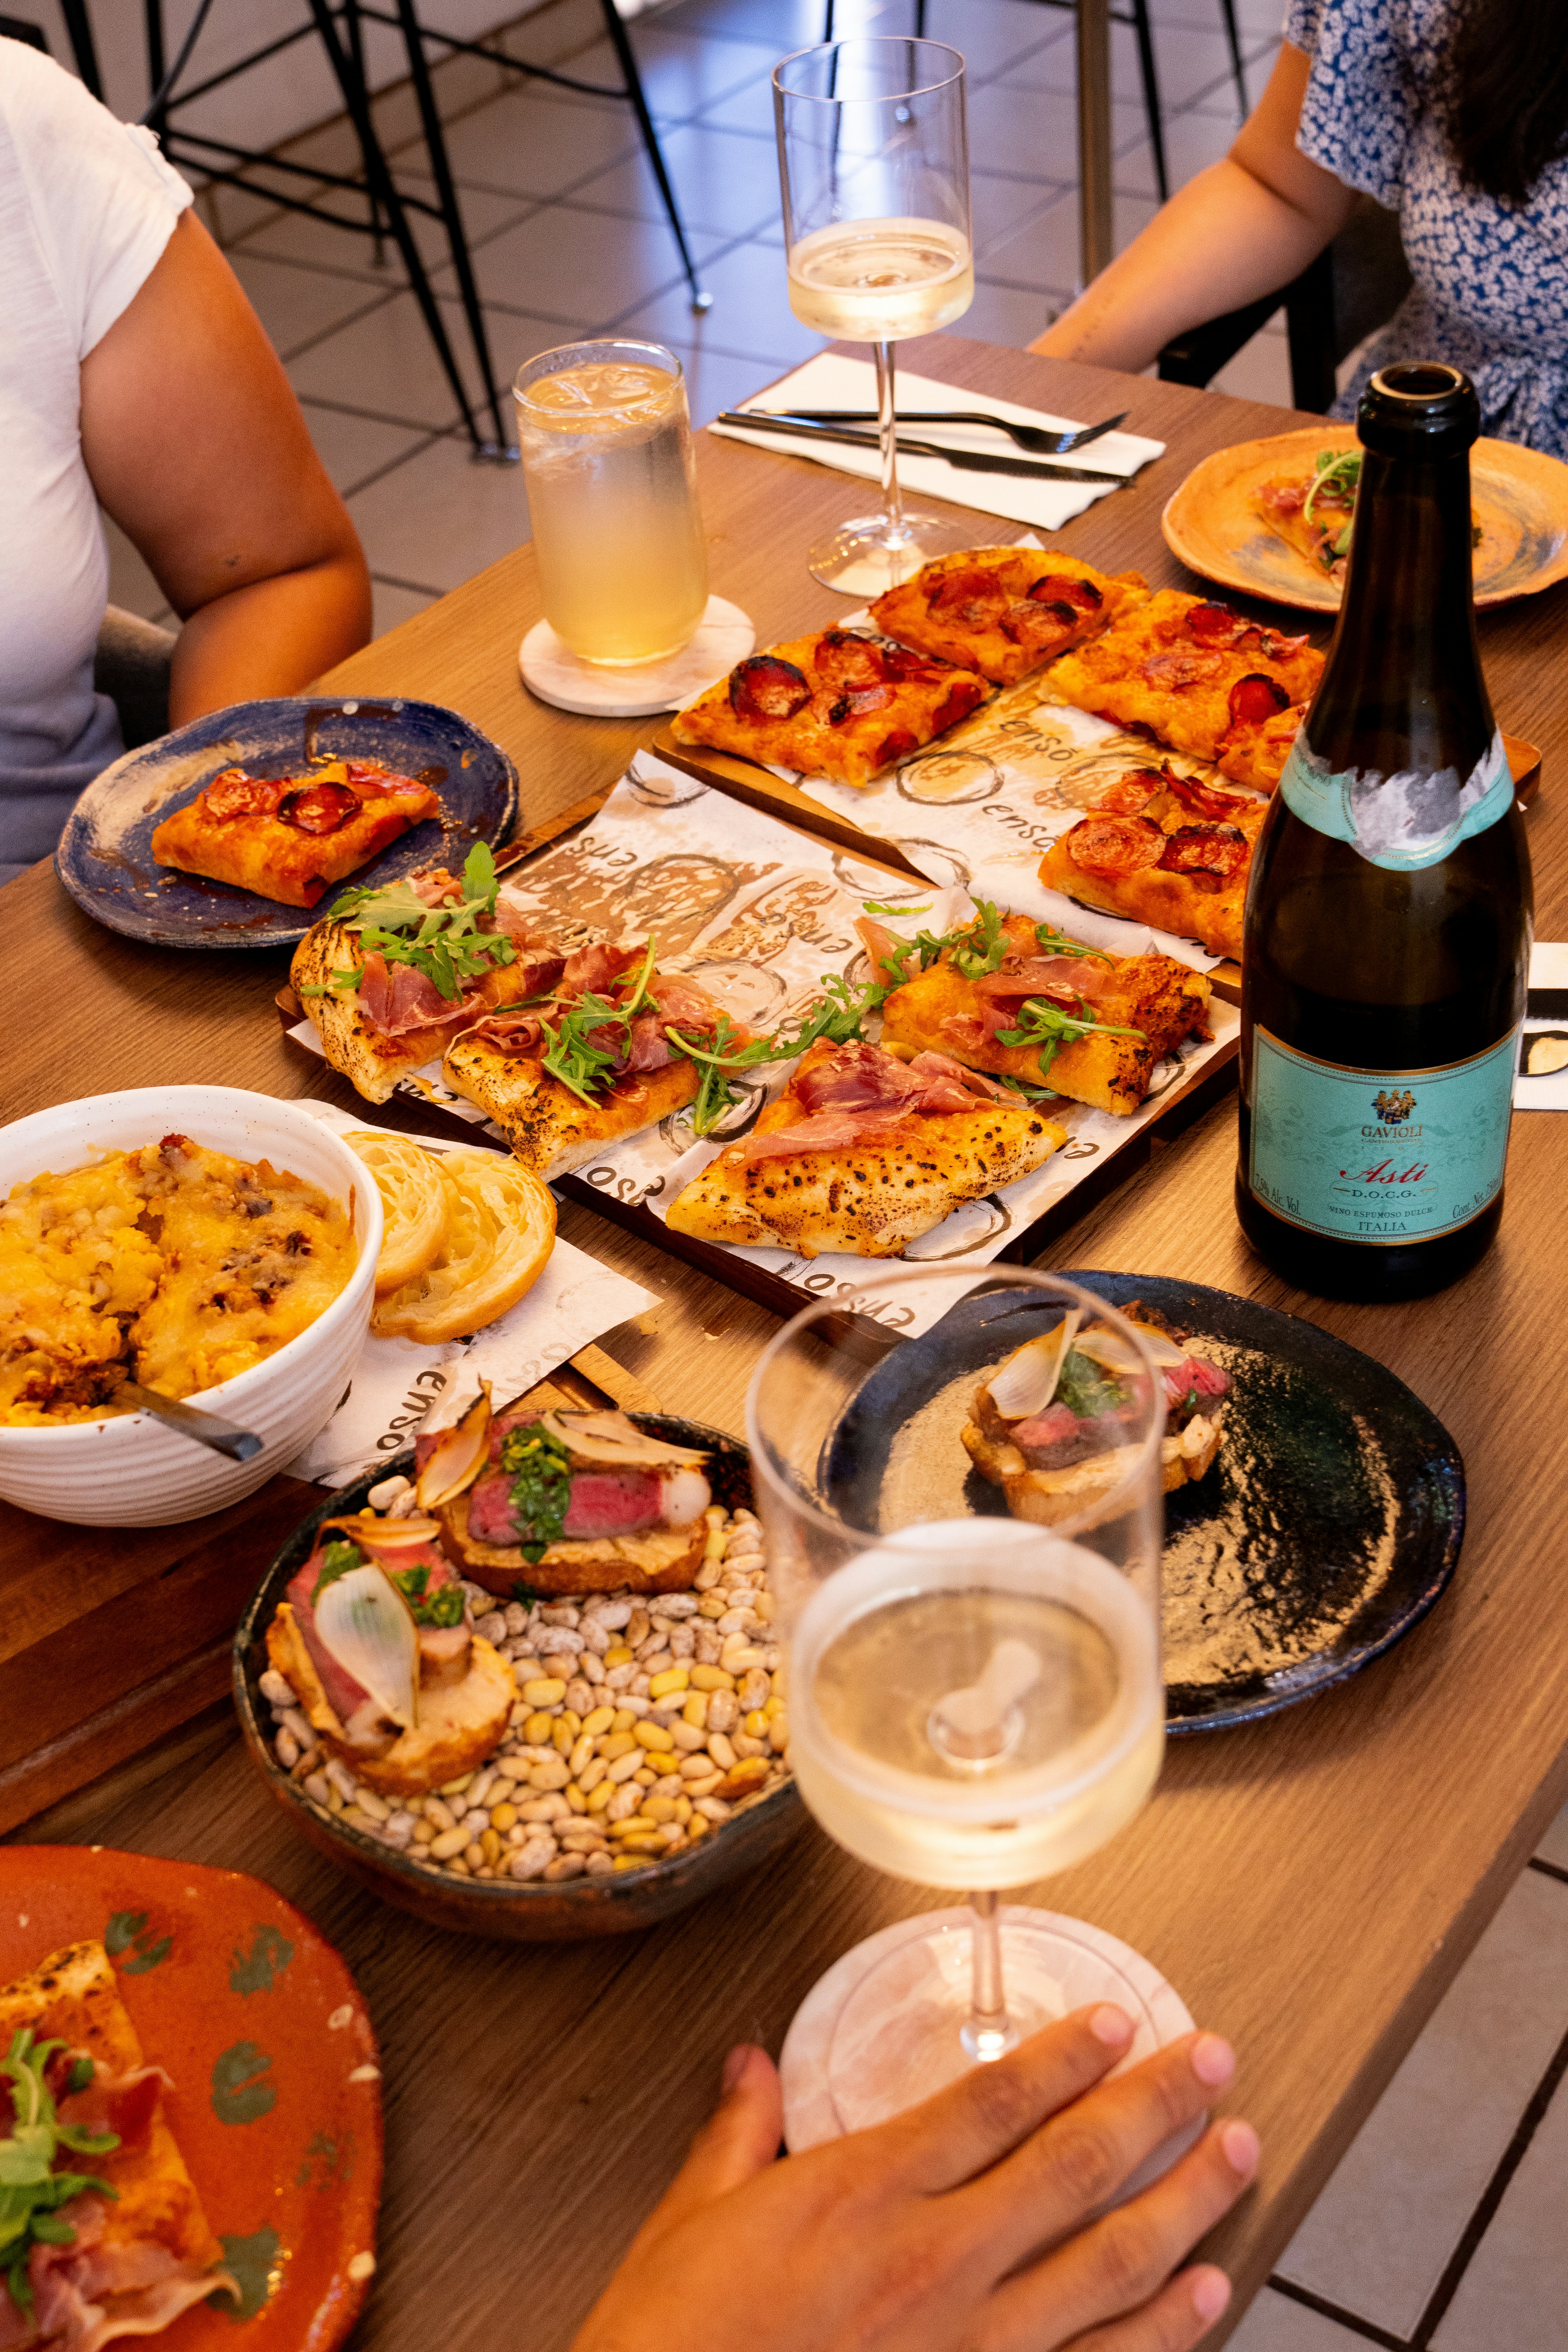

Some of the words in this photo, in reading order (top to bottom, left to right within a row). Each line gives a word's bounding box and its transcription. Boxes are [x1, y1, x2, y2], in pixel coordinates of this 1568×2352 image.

[1361, 1124, 1423, 1138] GAVIOLI
[1339, 1158, 1429, 1184] Asti
[1351, 1189, 1416, 1199] D.O.C.G.
[1287, 1195, 1301, 1215] Vol.
[1329, 1206, 1351, 1216] VINO
[1404, 1207, 1432, 1217] DULCE
[1358, 1221, 1407, 1231] ITALIA
